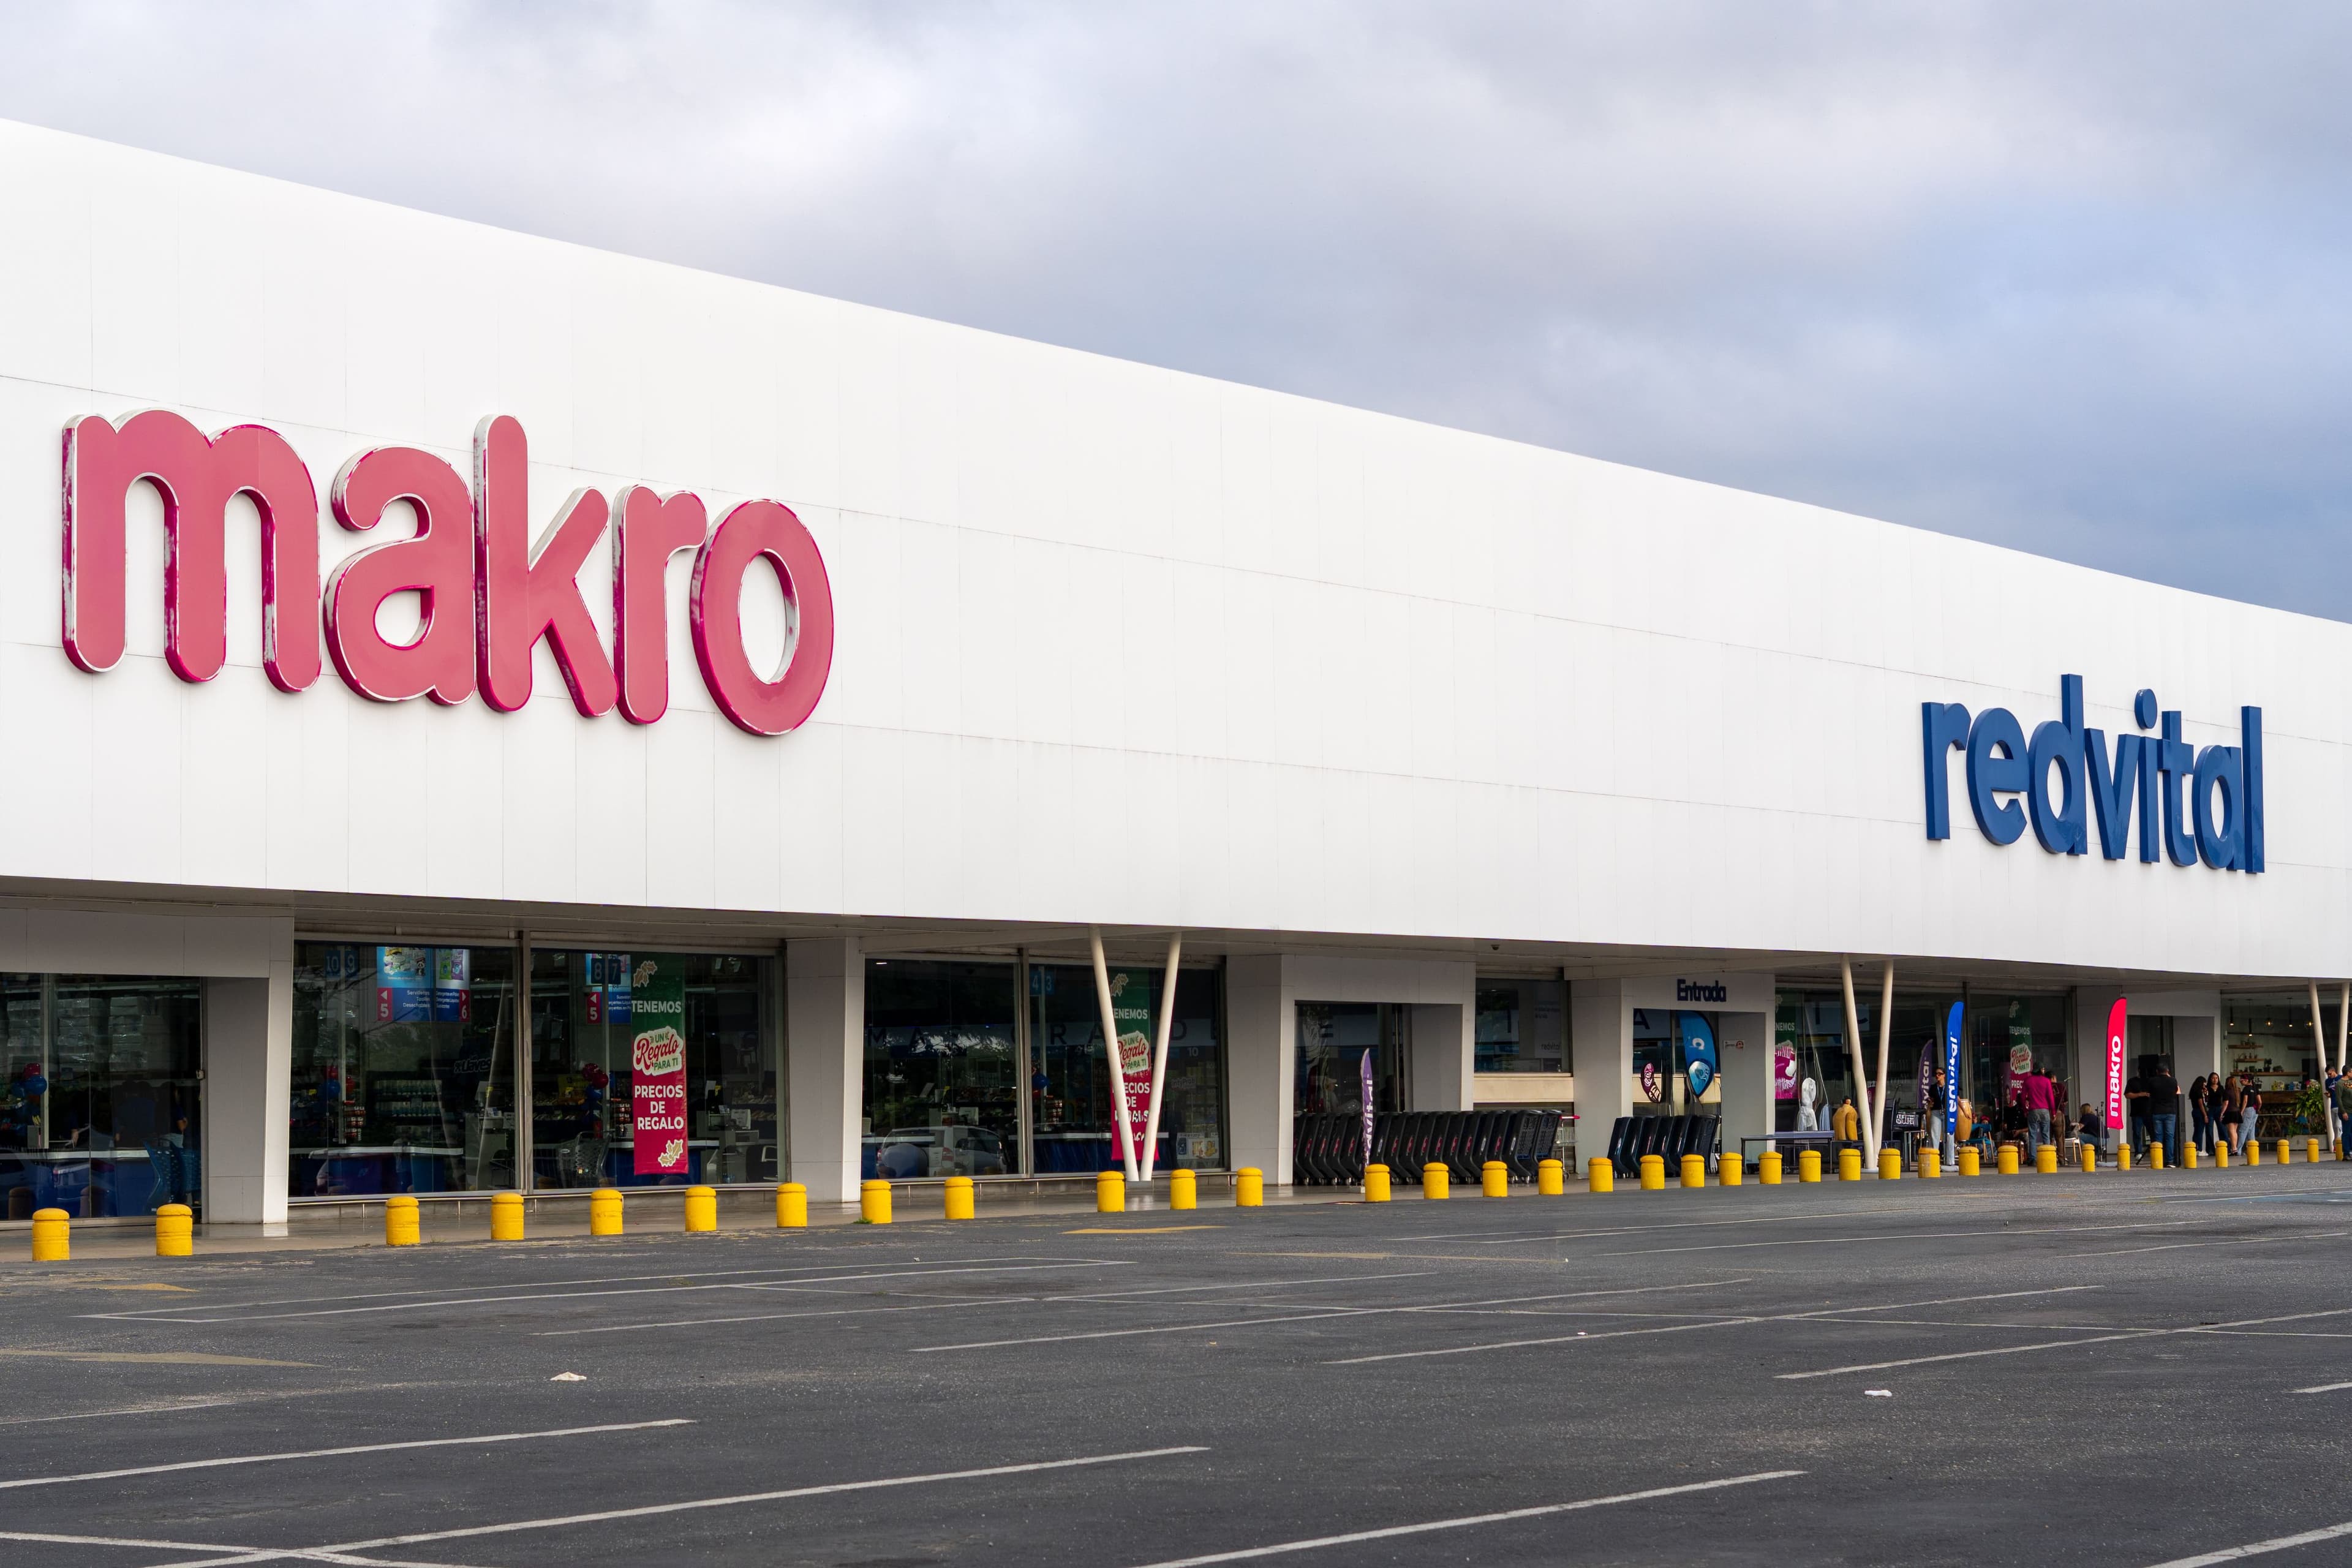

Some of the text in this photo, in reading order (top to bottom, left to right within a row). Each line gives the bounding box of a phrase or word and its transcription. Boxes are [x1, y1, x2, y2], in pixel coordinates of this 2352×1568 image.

[62, 407, 834, 735] makro
[1922, 674, 2264, 873] redvital
[326, 956, 339, 972] 10
[347, 954, 355, 974] 9
[594, 962, 602, 980] 8
[612, 963, 618, 981] 7
[1032, 974, 1039, 990] 4
[1046, 975, 1052, 990] 3
[1676, 979, 1727, 1002] Entrada
[380, 1003, 389, 1018] 5
[461, 1006, 467, 1019] 6
[631, 1000, 681, 1013] TENEMOS
[589, 1007, 598, 1020] 5
[1114, 1008, 1148, 1020] ENEMOS
[1775, 1022, 1795, 1031] NEMOS
[2009, 1026, 2030, 1035] TENEMOS
[655, 1033, 664, 1043] UN
[636, 1034, 679, 1070] Regalo
[654, 1058, 678, 1071] PARA TI
[1128, 1060, 1141, 1070] PARA
[2109, 1035, 2122, 1117] makro
[1123, 1082, 1150, 1094] ECIOS
[2011, 1079, 2024, 1089] PREC
[635, 1085, 684, 1098] PRECIOS
[650, 1101, 666, 1114] DE
[638, 1117, 684, 1130] REGALO
